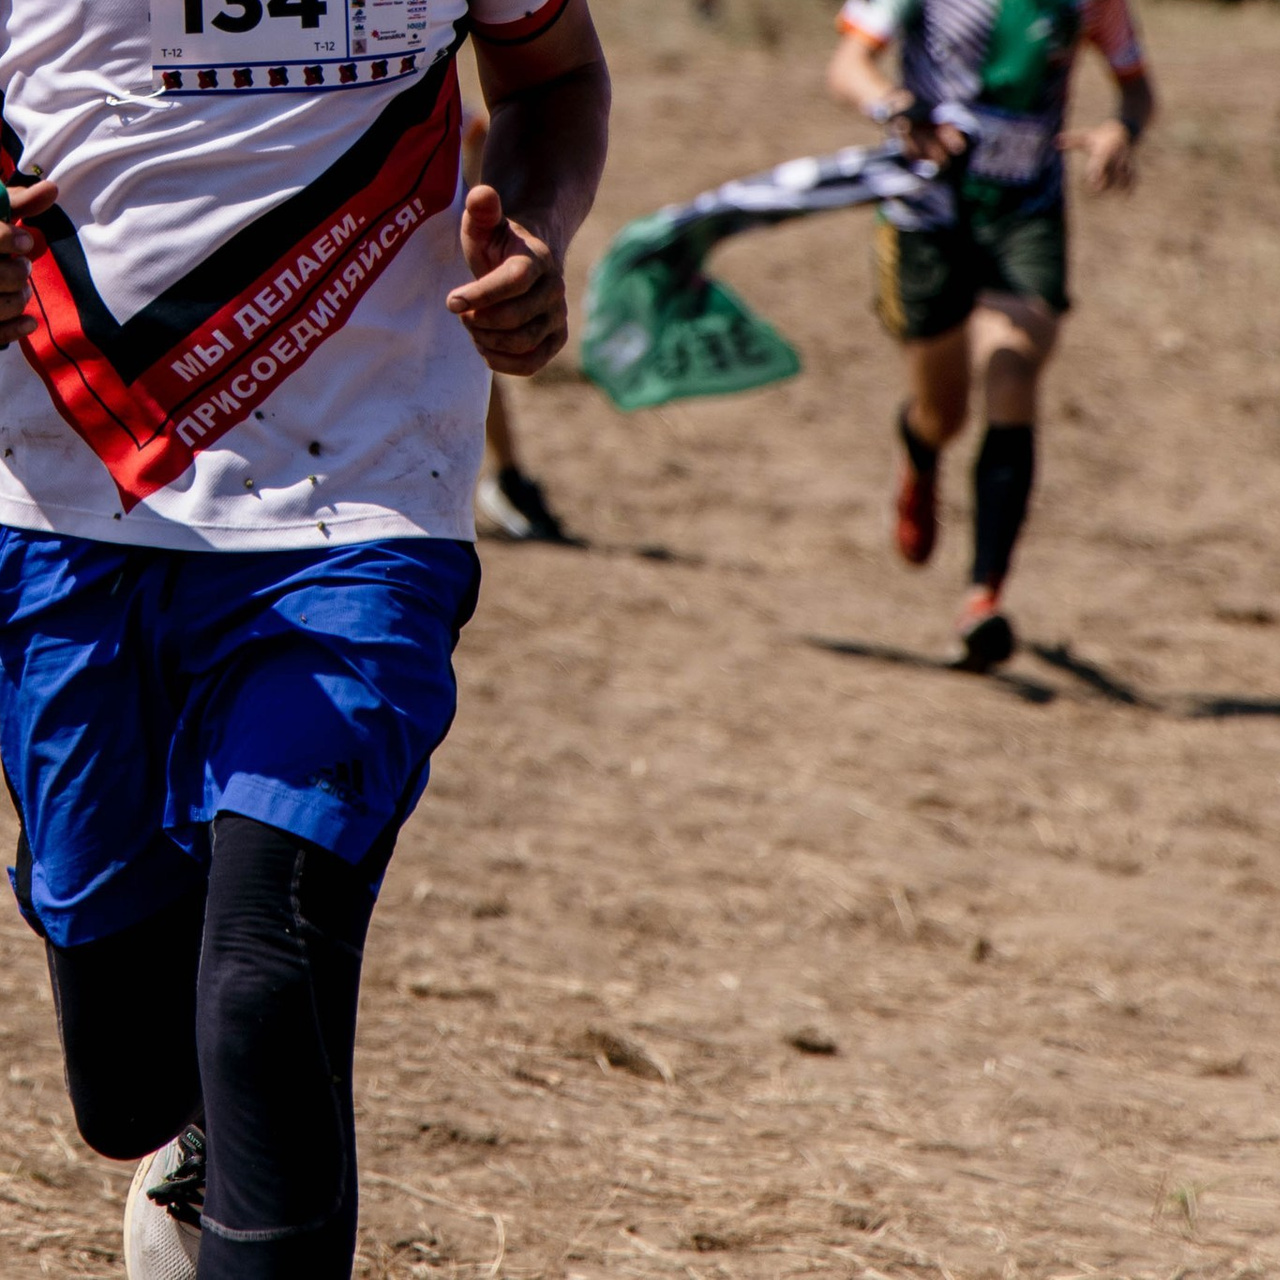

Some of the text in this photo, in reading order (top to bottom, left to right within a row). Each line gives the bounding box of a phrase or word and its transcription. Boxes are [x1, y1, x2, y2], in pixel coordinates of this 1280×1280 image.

[170, 212, 366, 383] МЫ ДЕЛАЕМ.
[174, 197, 426, 448] ПРИСОЕДИНЯЙСЯ!
